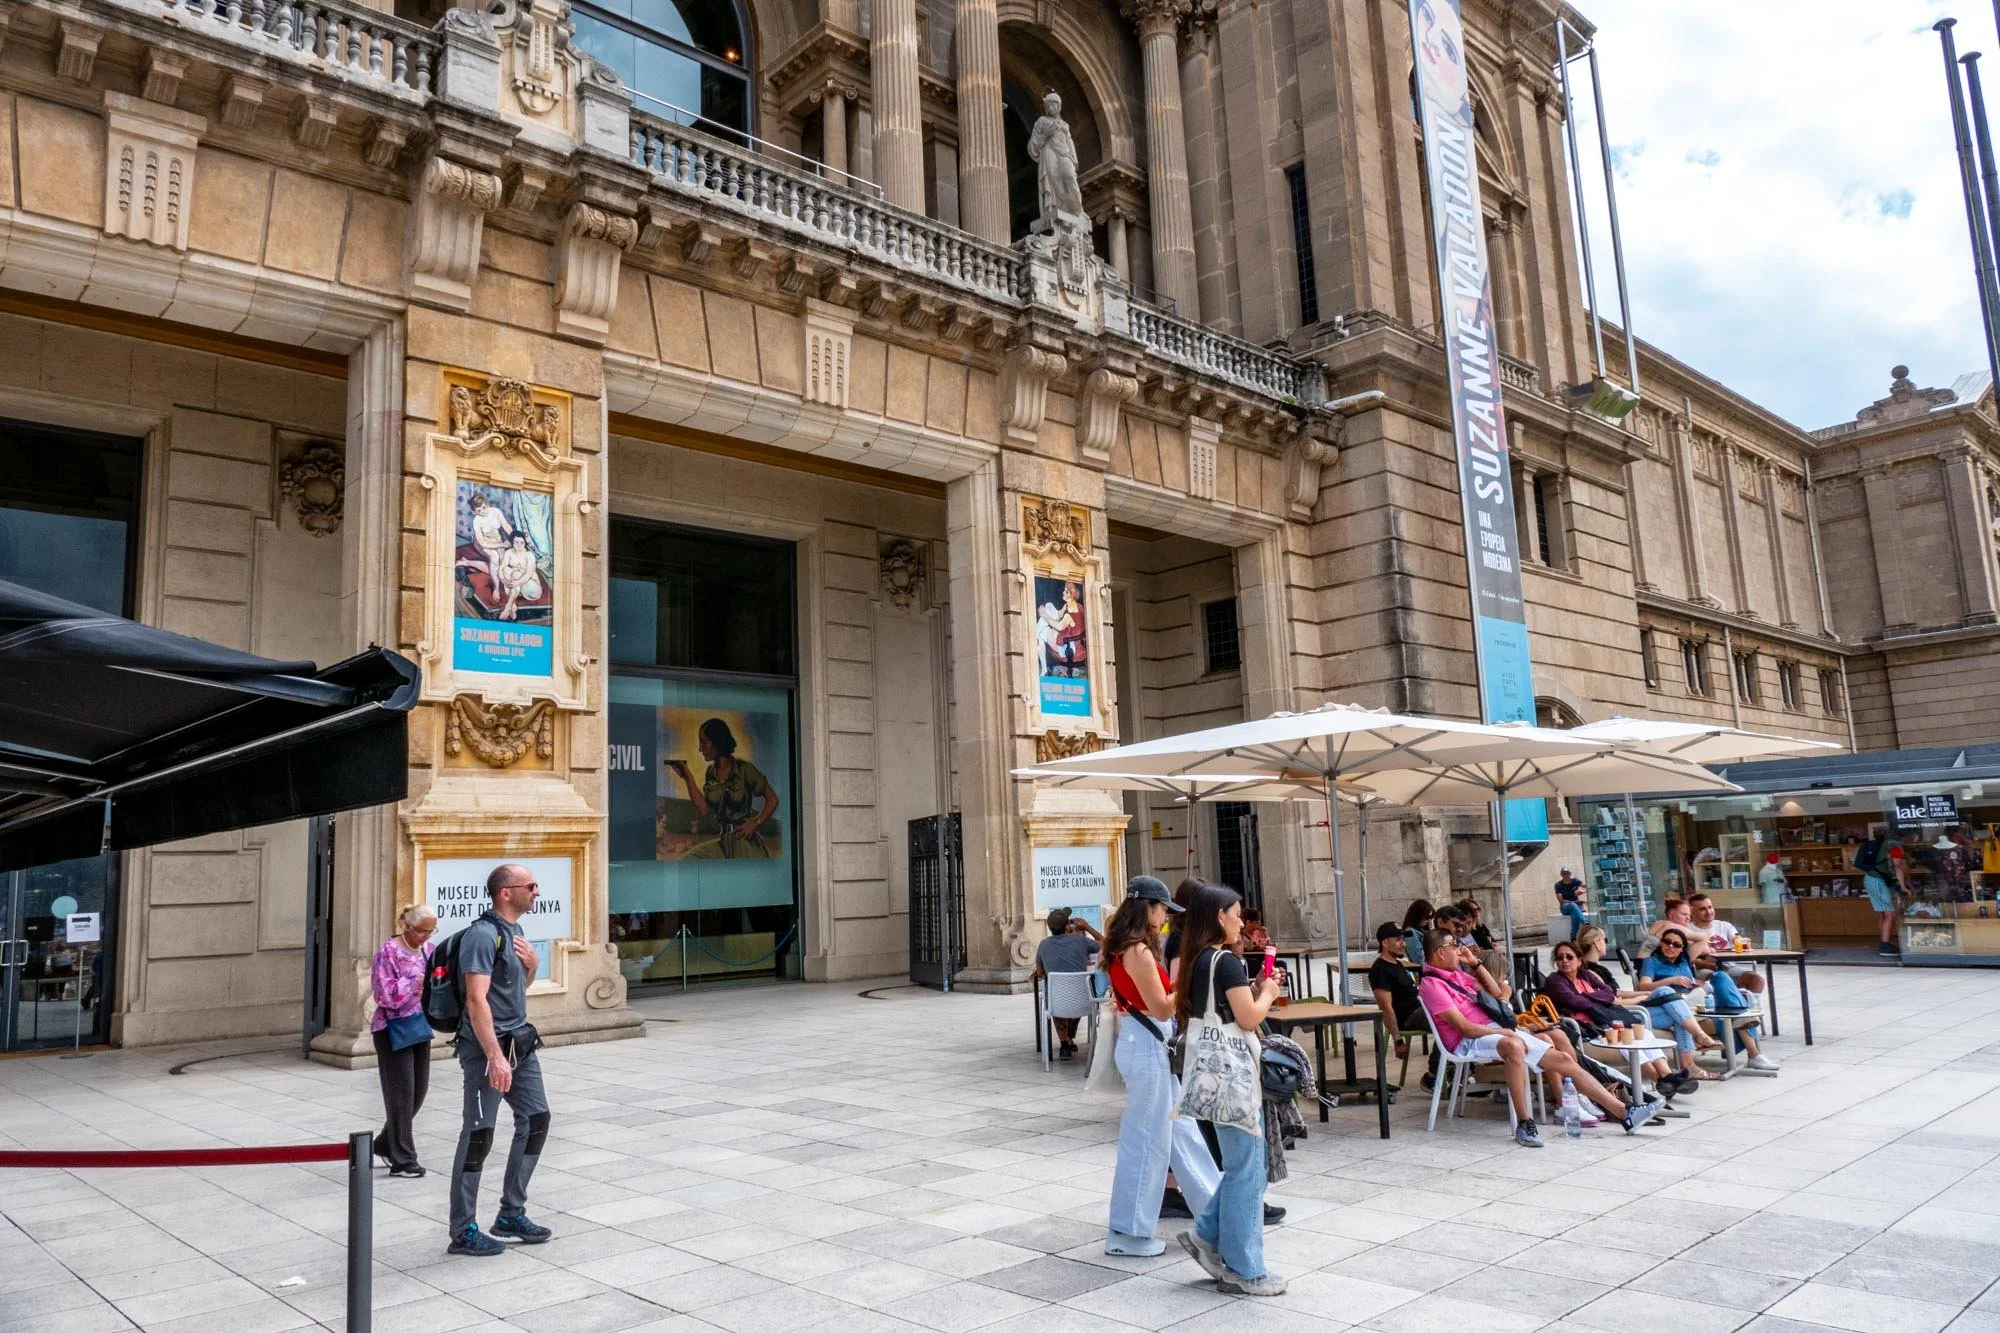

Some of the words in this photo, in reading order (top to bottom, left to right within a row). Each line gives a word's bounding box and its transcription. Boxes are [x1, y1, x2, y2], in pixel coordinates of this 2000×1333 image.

[1435, 116, 1483, 300] VALADON
[1456, 309, 1504, 505] SUZANNE
[1478, 510, 1492, 529] UNA
[1480, 530, 1506, 553] EPOPEIA
[1482, 550, 1512, 573] MODERNA
[460, 627, 501, 644] SUZANNE
[503, 631, 543, 648] VALADON
[608, 744, 645, 771] CIVIL
[1896, 804, 1926, 819] laie
[1040, 865, 1061, 876] MUSEU
[1063, 864, 1094, 876] NACIONAL
[438, 885, 478, 901] MUSEU
[1041, 878, 1060, 889] D'ART
[1061, 878, 1070, 888] DE
[1071, 877, 1106, 888] CATALUNYA
[437, 903, 473, 919] D'ART
